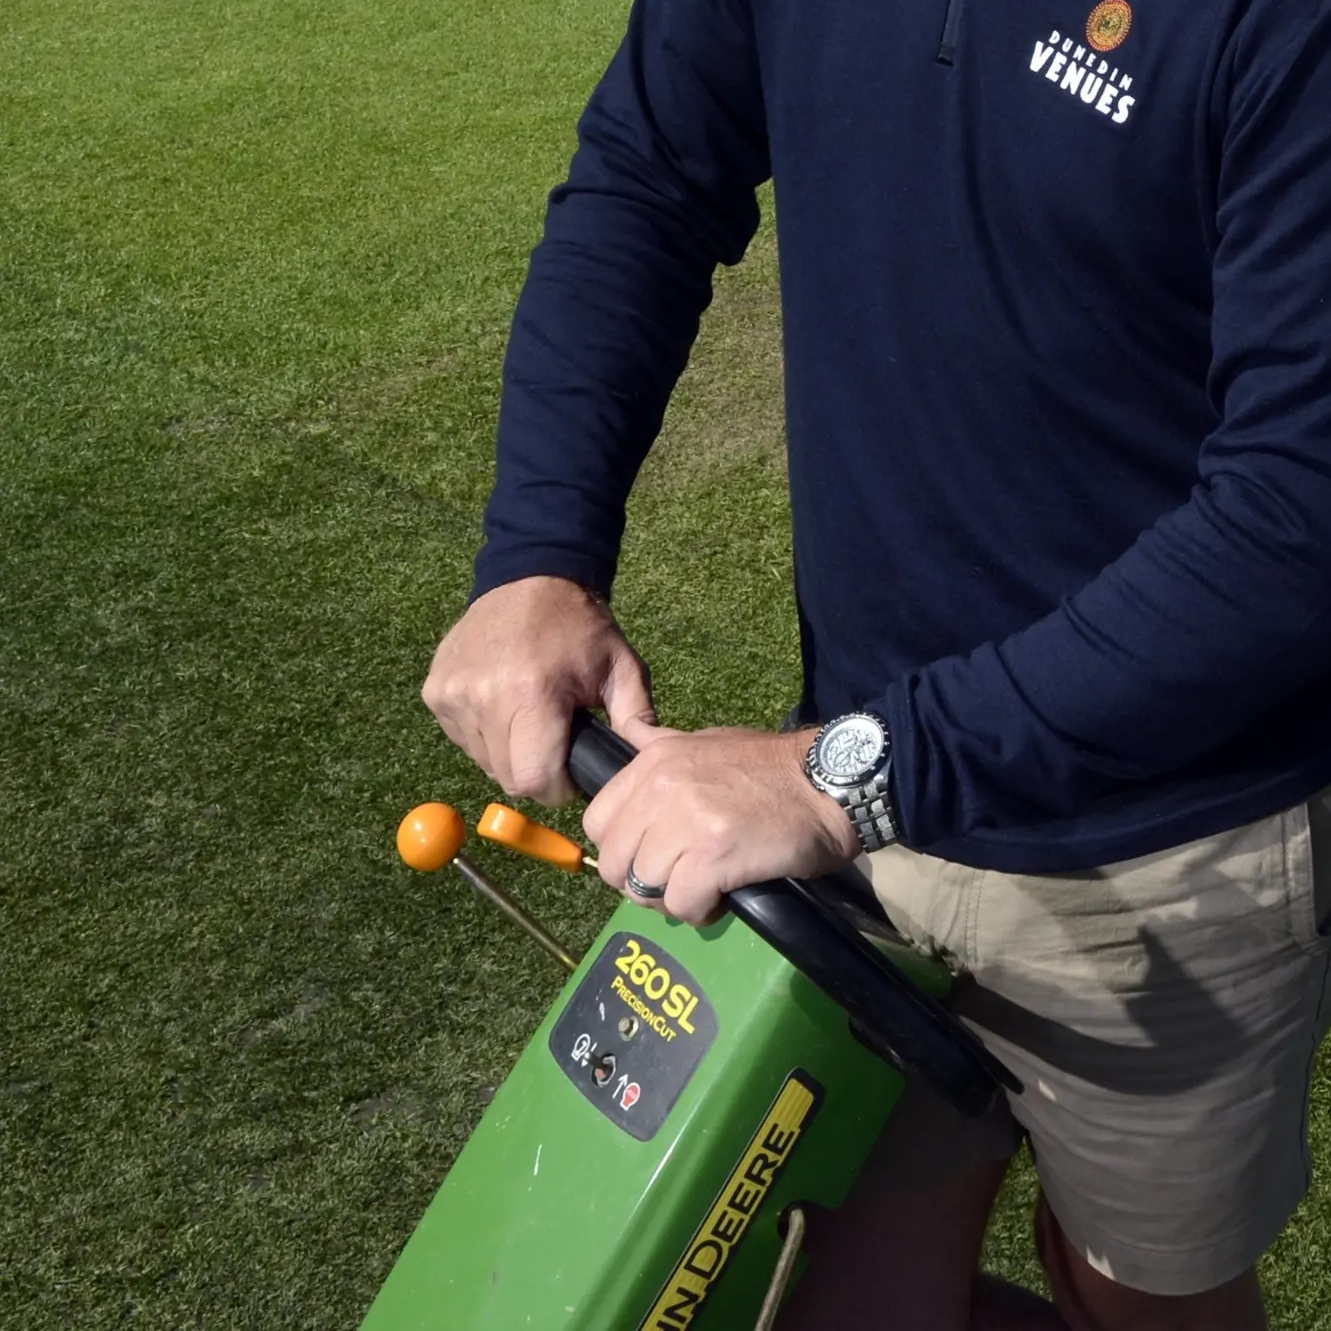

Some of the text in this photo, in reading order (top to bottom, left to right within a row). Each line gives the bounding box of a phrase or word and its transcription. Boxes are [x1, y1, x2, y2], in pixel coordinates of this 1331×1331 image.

[1029, 40, 1136, 124] VENUES
[1048, 30, 1133, 91] DUNEDIN
[683, 1122, 795, 1281] DEERE
